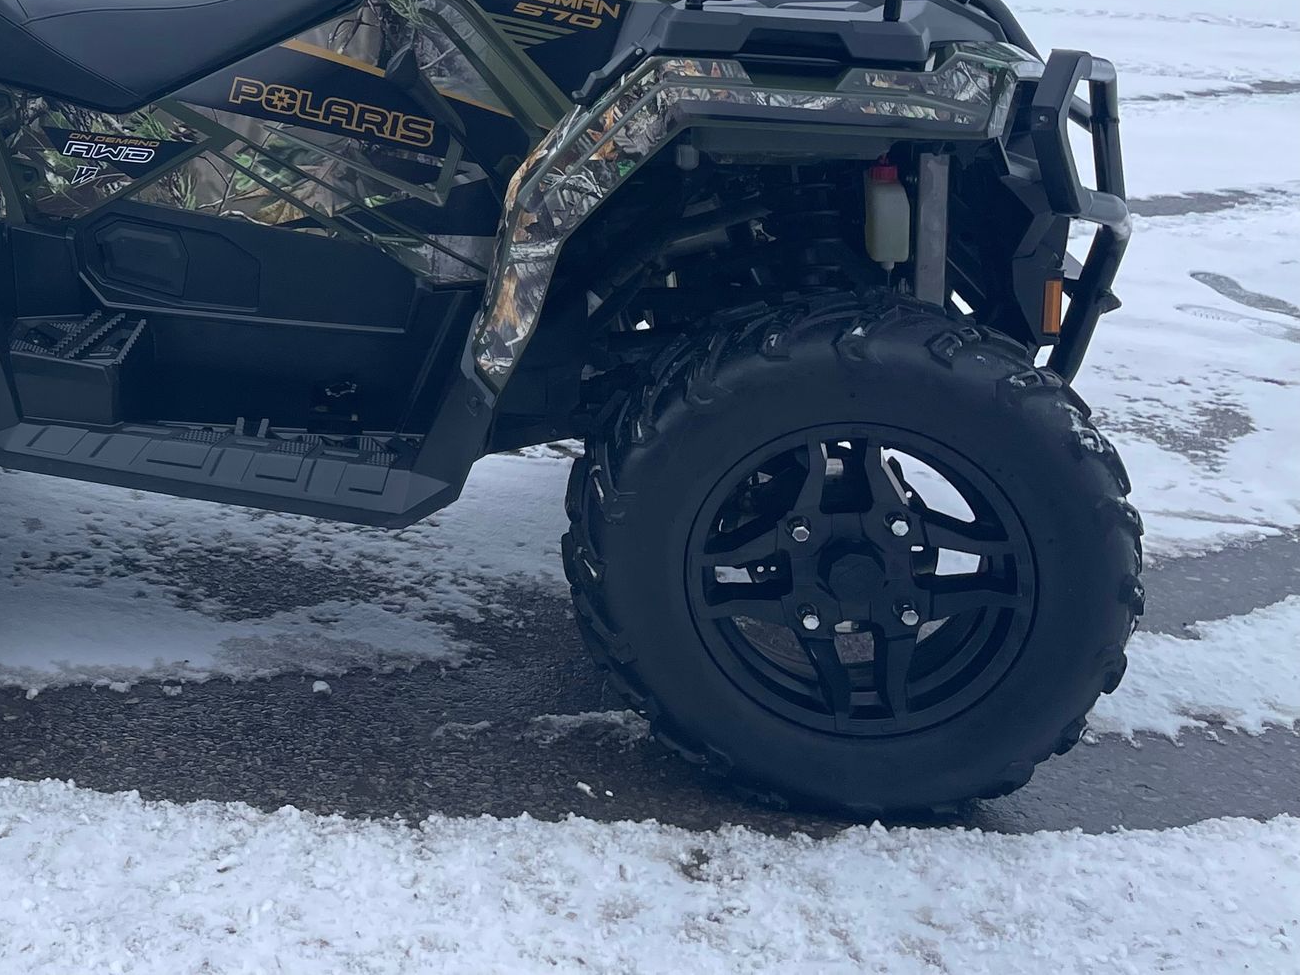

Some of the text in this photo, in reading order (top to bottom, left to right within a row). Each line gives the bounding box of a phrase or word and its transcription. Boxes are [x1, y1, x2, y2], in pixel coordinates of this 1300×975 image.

[513, 1, 602, 29] 570
[228, 76, 435, 147] POLARIS
[62, 140, 155, 164] AWD
[69, 132, 160, 148] ON DEMAND
